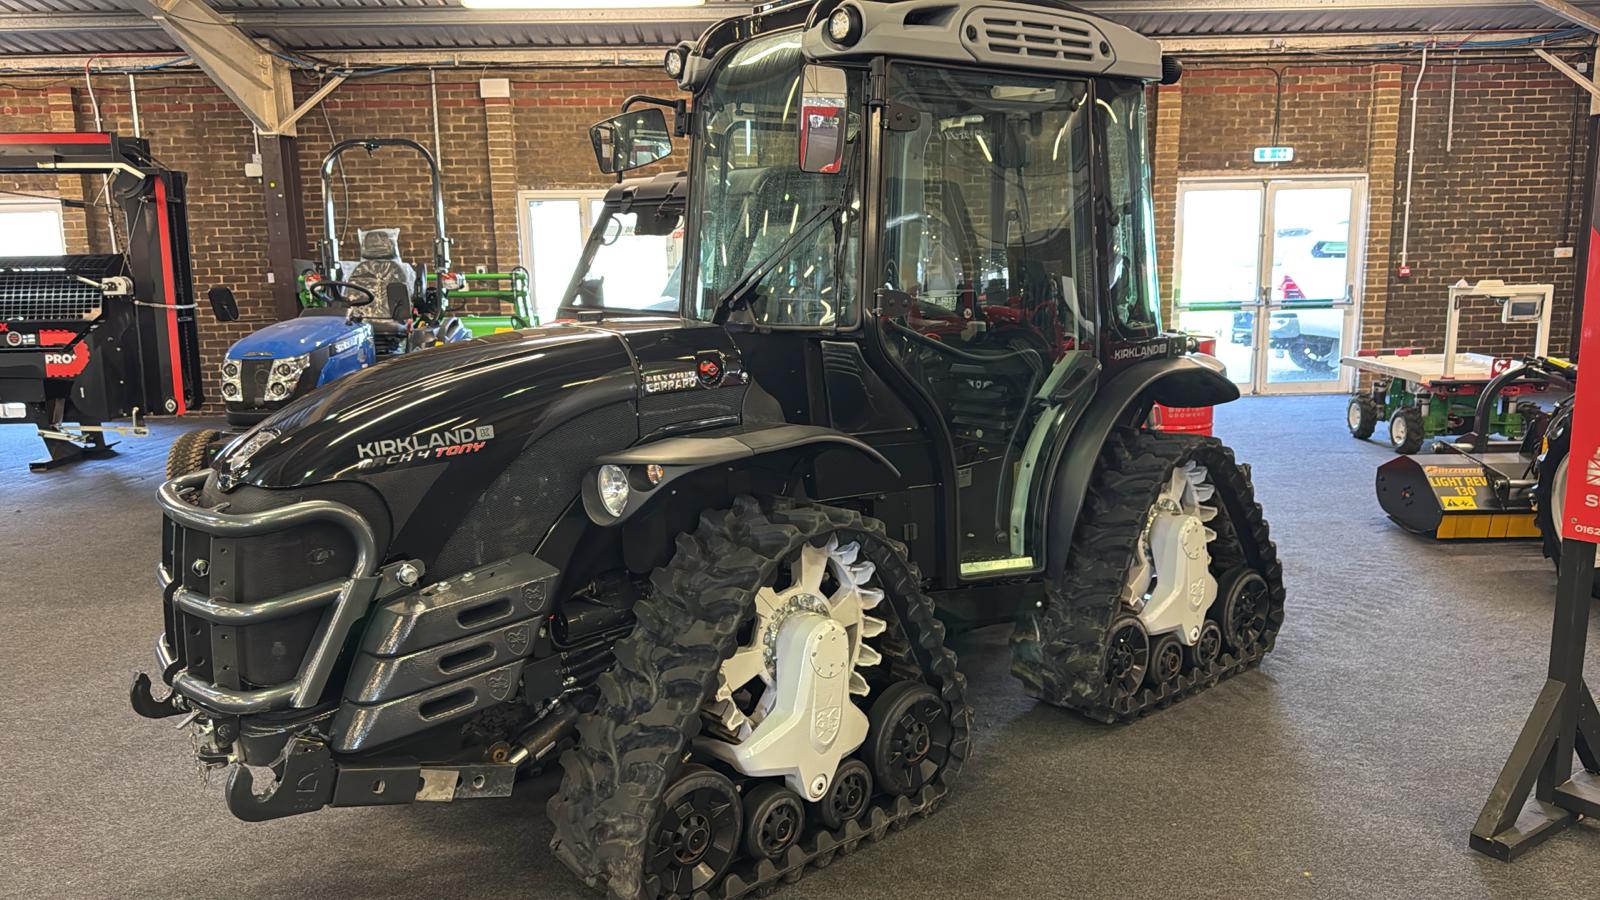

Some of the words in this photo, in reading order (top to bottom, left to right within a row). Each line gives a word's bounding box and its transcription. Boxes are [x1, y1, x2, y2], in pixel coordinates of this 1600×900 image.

[1114, 344, 1159, 360] KIRKLAND
[645, 371, 696, 382] ANTONIO
[645, 378, 697, 392] CARRARO
[357, 428, 475, 458] KIRKLAND
[418, 450, 431, 459] 4
[435, 441, 487, 458] TONY
[1430, 476, 1463, 487] LIGHT
[1464, 476, 1488, 487] REV
[1454, 487, 1477, 496] 130
